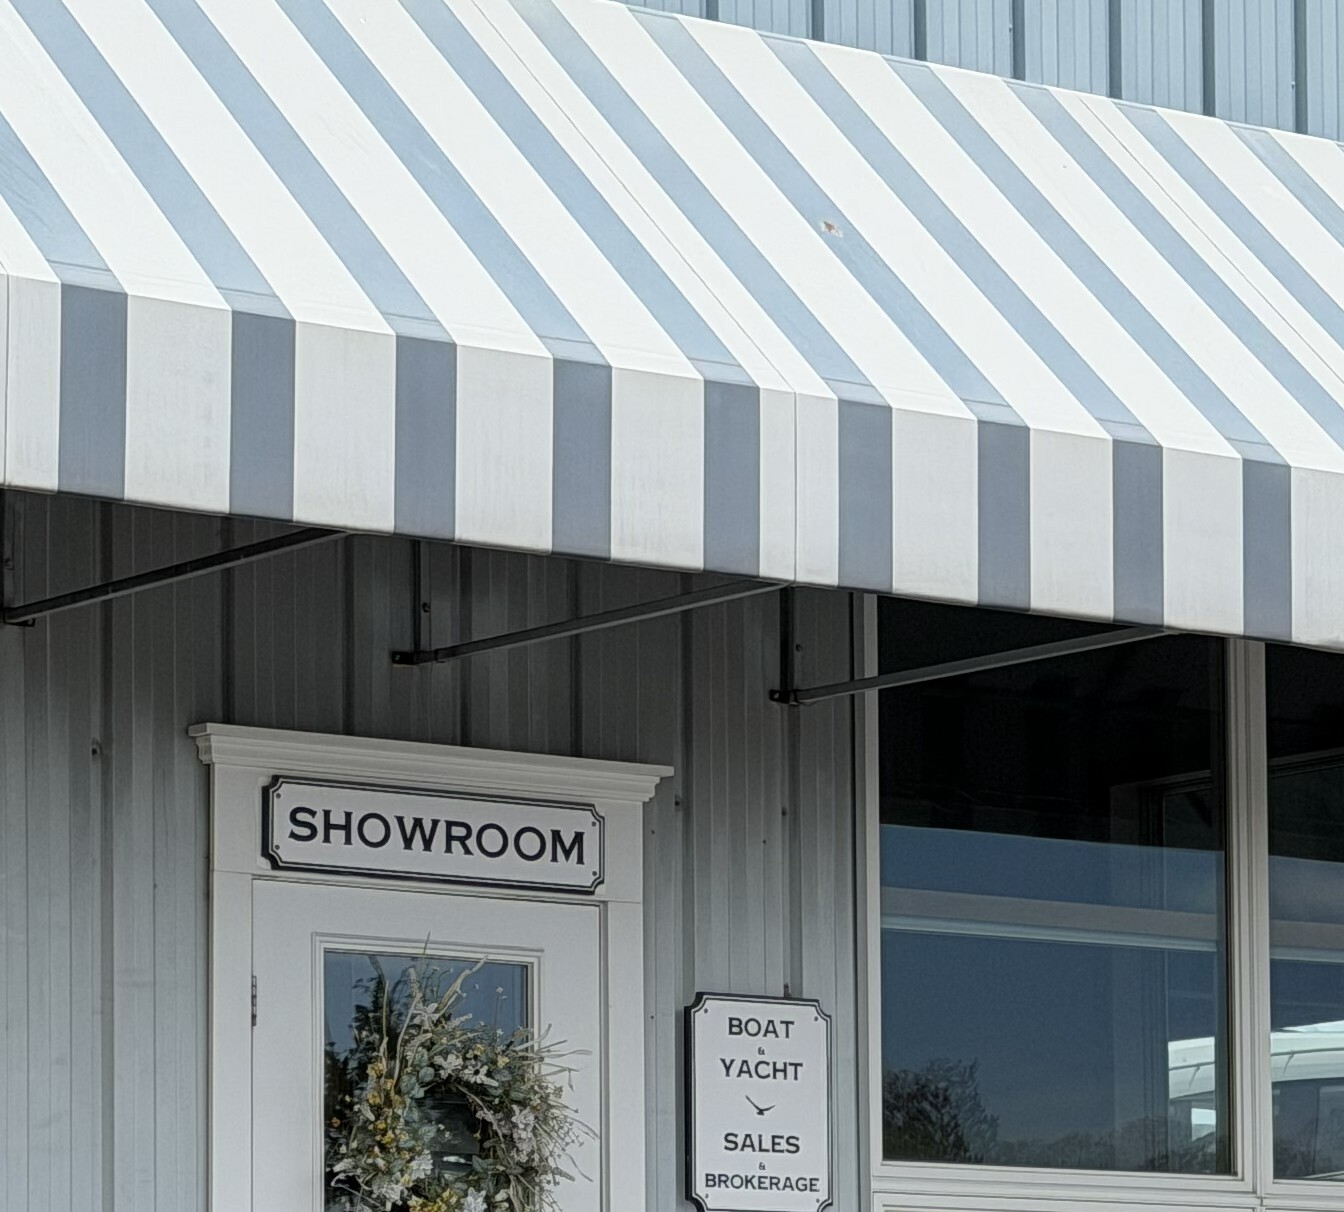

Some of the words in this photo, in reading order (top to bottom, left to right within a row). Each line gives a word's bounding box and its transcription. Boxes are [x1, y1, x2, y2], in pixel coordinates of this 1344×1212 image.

[288, 806, 585, 867] SHOWROOM
[728, 1017, 795, 1039] BOAT
[719, 1057, 804, 1081] YACHT
[723, 1132, 800, 1154] SALES
[705, 1173, 820, 1193] BROKERAGE
